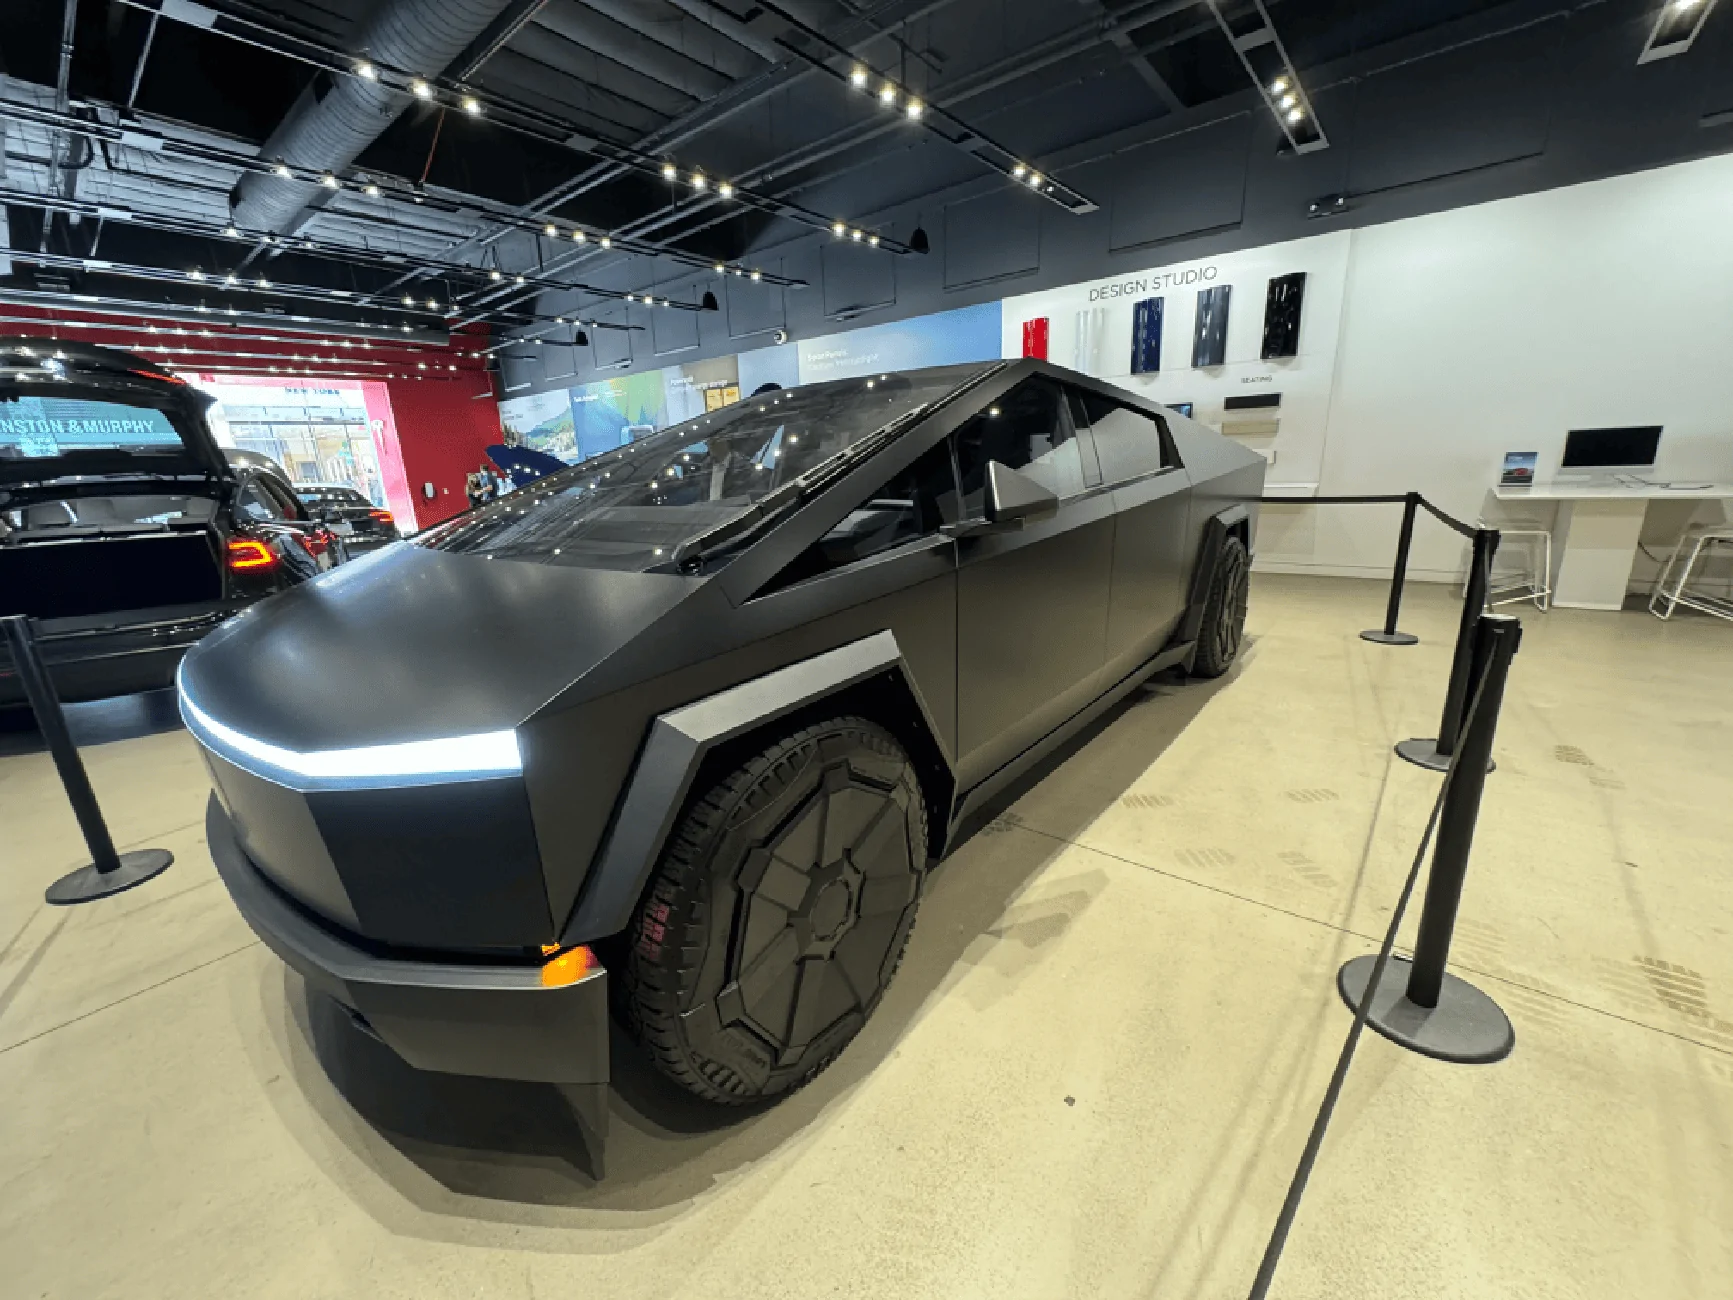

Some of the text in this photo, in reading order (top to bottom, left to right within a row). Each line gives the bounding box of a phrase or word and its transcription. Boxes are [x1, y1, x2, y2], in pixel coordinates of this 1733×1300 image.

[1089, 266, 1218, 302] DESIGN STUDIO
[1240, 375, 1273, 384] SEATING
